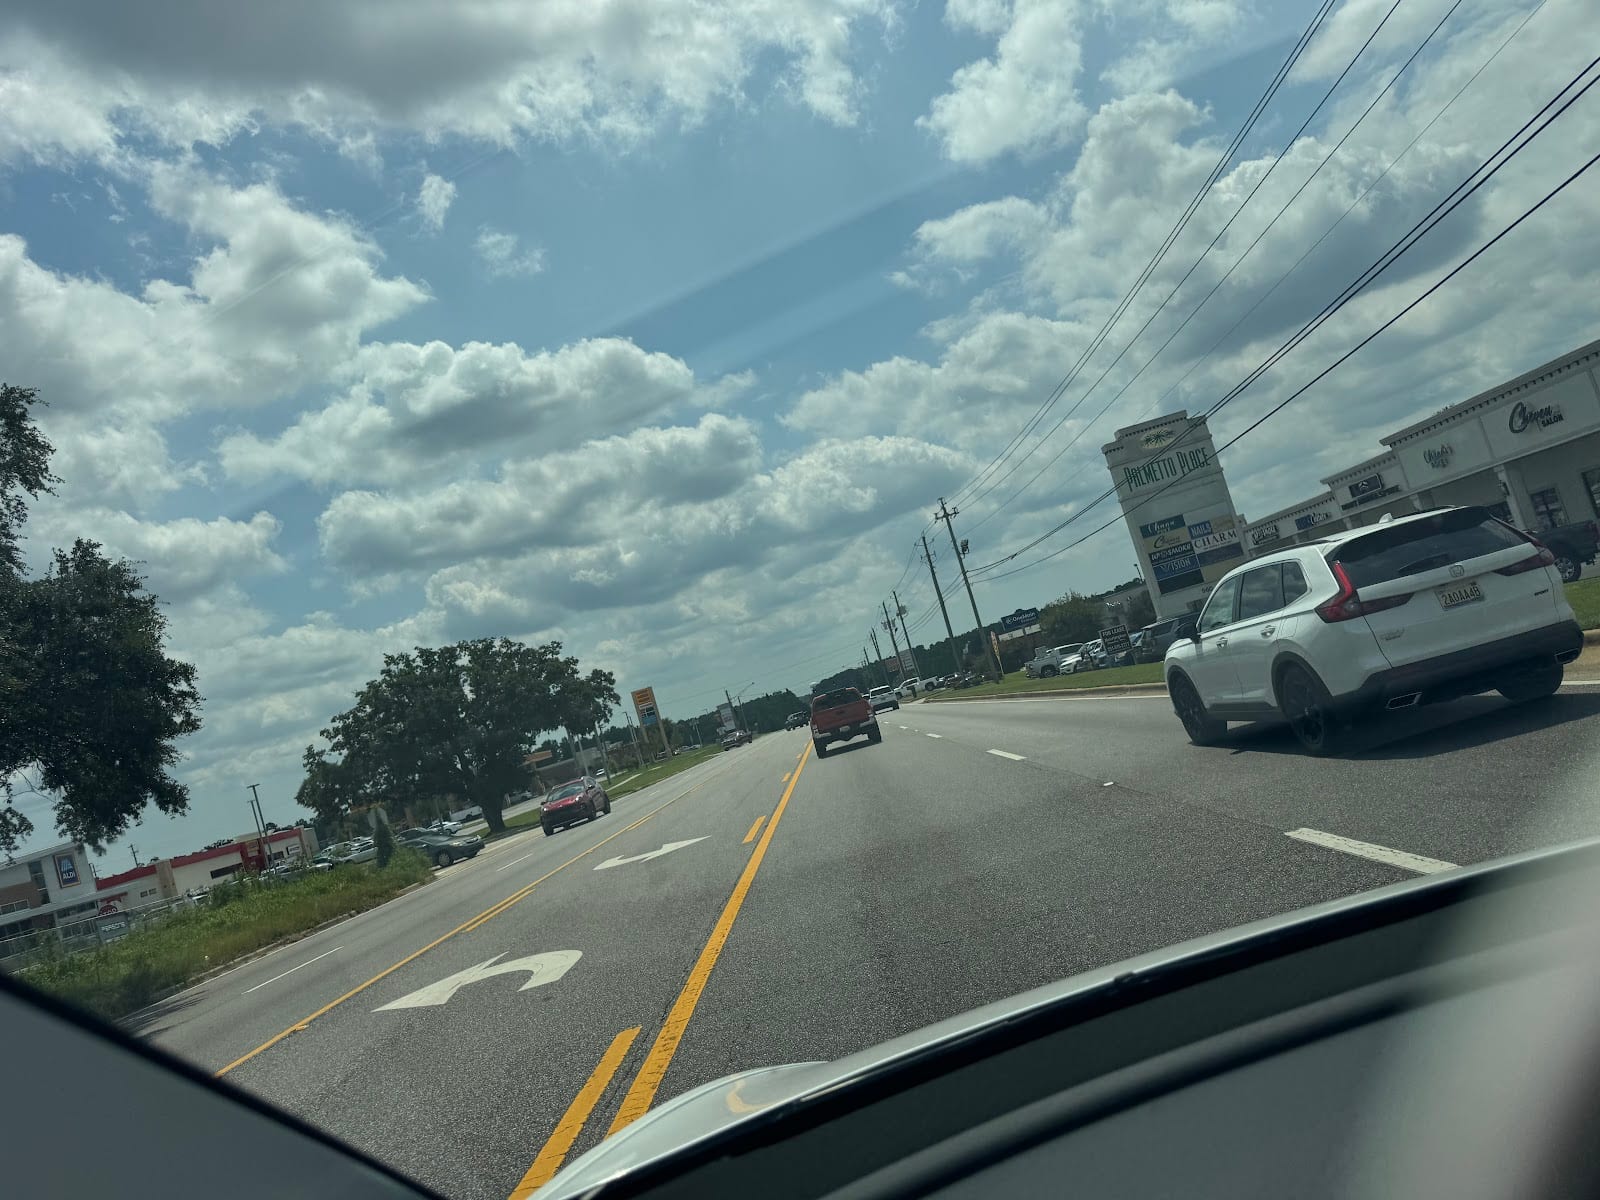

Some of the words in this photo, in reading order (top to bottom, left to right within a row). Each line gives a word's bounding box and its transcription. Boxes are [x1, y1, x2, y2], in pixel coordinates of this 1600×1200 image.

[1123, 456, 1178, 492] PALMETTO
[1177, 447, 1211, 476] PLACE
[1194, 529, 1238, 549] CHARM
[1111, 626, 1127, 635] LEASE
[62, 870, 76, 881] ALDI
